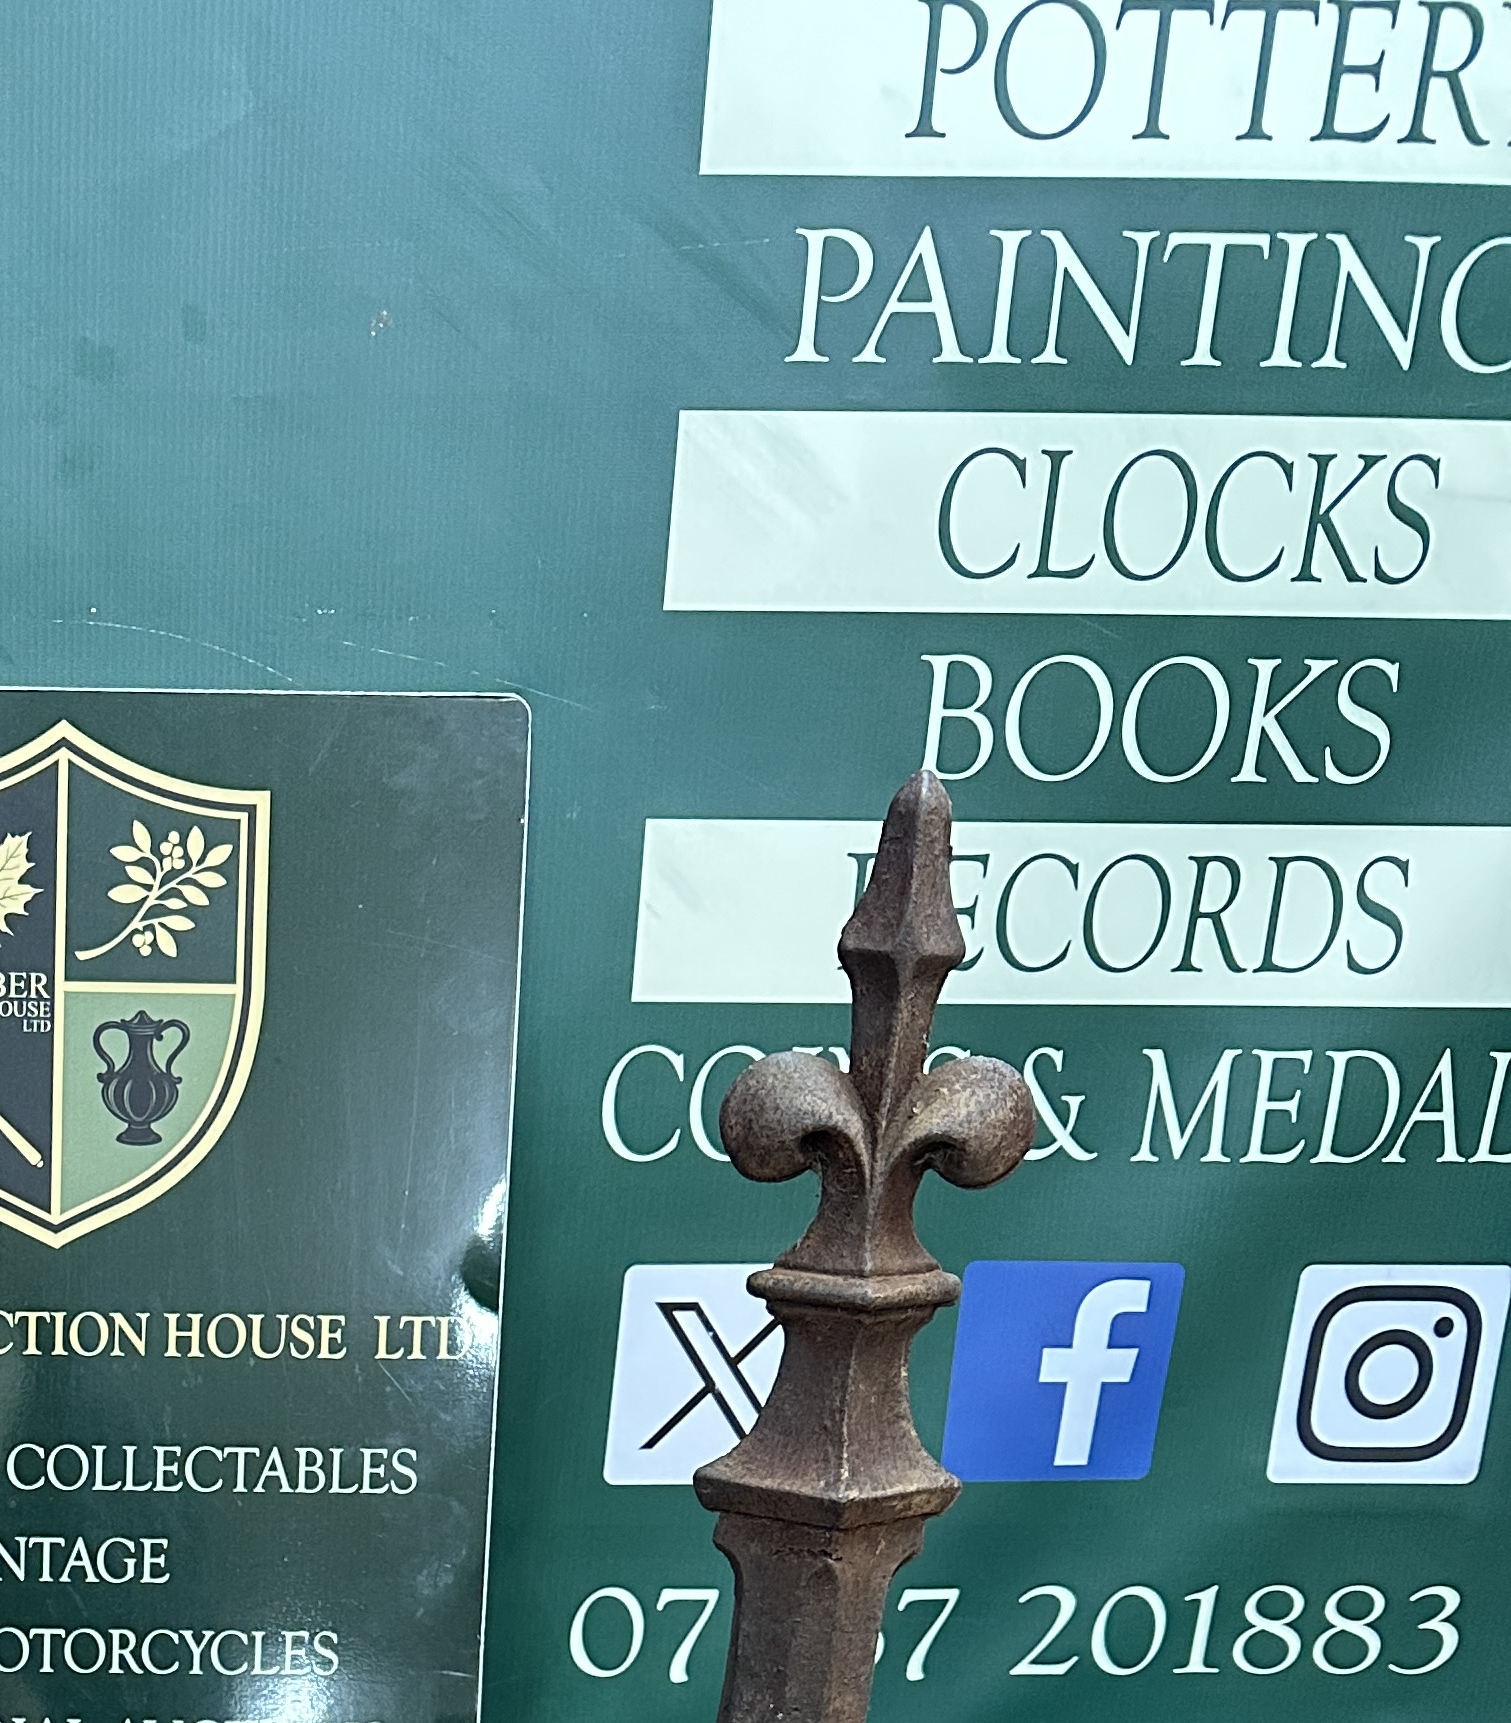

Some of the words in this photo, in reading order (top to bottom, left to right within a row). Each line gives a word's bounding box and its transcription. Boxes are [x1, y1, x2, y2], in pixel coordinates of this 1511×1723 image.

[906, 0, 1511, 146] POTTER
[938, 447, 1442, 586] CLOCKS
[920, 653, 1401, 785] BOOKS
[22, 1019, 52, 1033] LTD
[163, 1314, 347, 1361] HOUSE
[6, 1442, 419, 1496] COLLECTABLES
[1010, 1584, 1463, 1677] 201883
